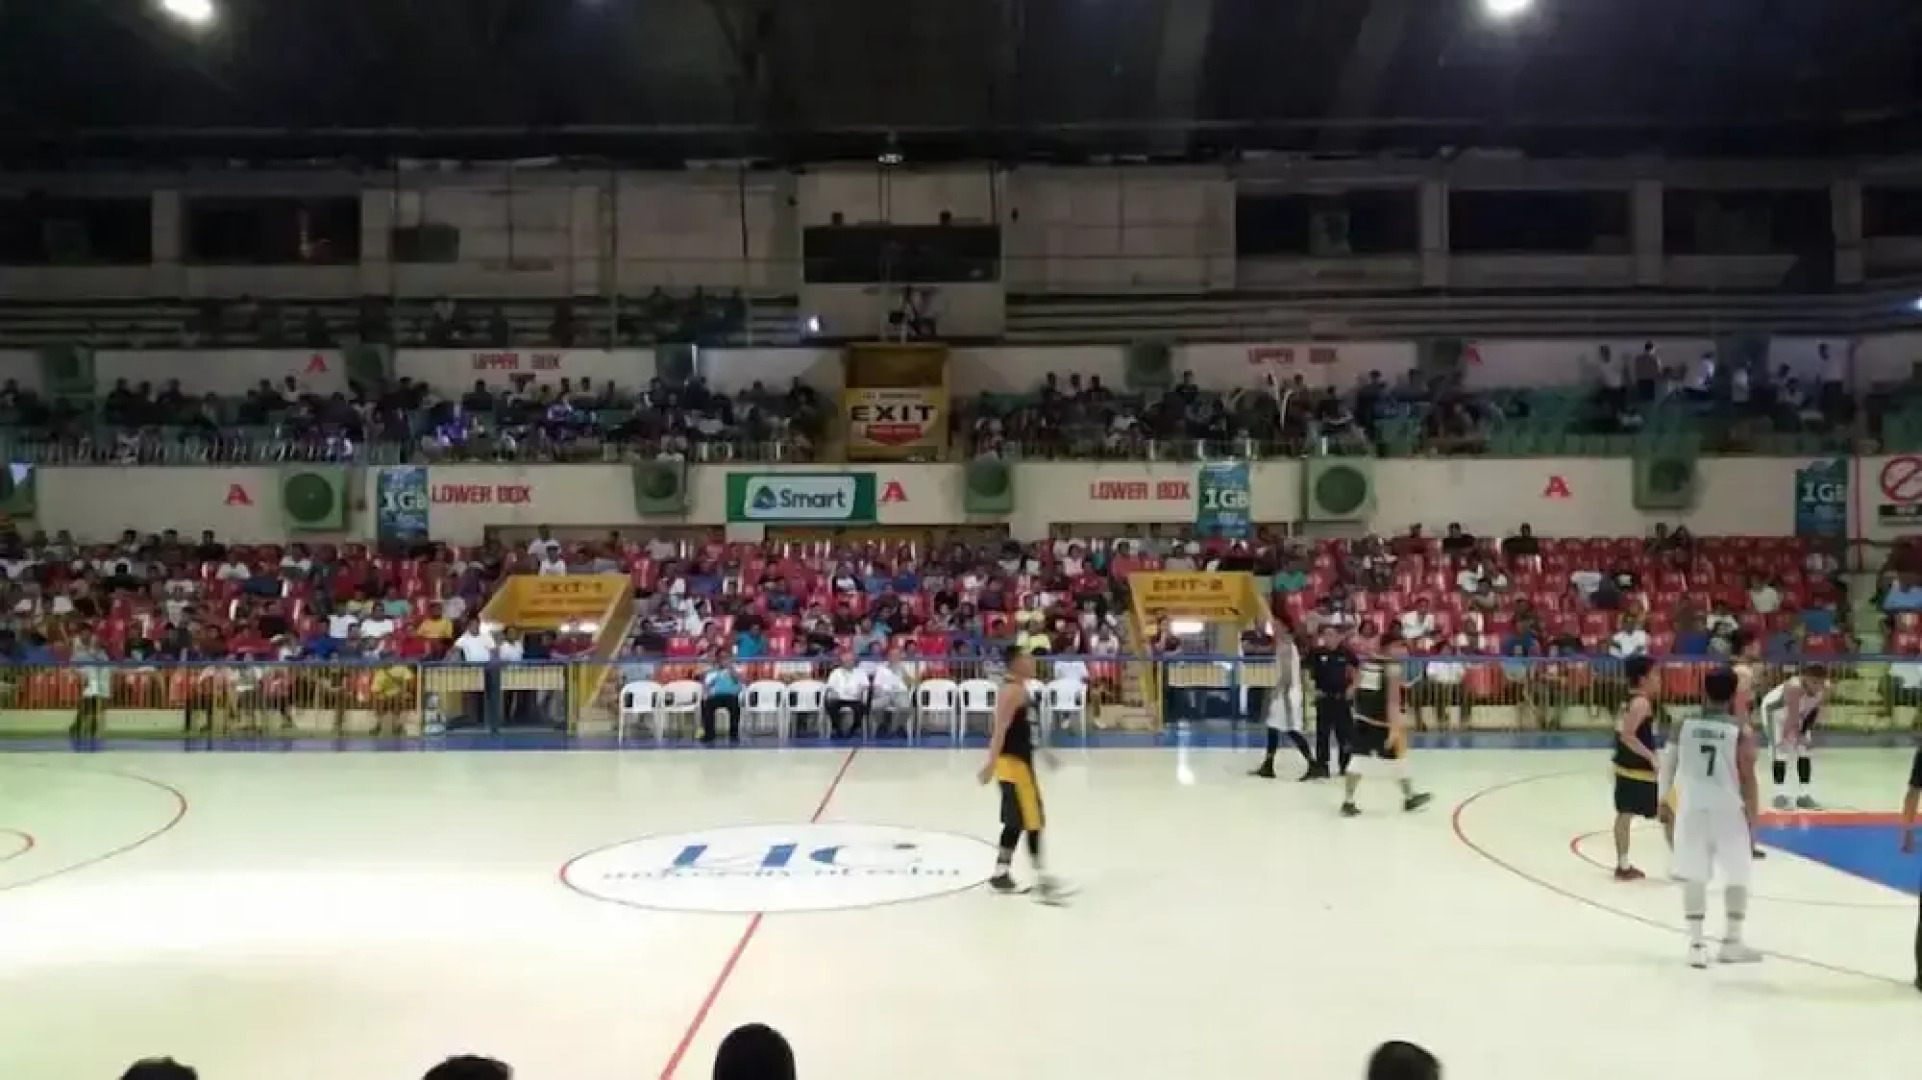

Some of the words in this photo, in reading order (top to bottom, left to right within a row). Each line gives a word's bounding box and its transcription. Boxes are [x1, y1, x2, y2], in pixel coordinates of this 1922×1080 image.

[306, 354, 329, 372] A
[472, 353, 519, 370] UPPER
[531, 353, 561, 370] BOX
[850, 404, 936, 422] EXIT
[223, 483, 255, 506] A
[430, 484, 491, 504] LOWER
[497, 484, 532, 504] BOX
[880, 480, 909, 502] A
[1090, 481, 1149, 500] LOWER
[1156, 480, 1191, 500] BOX
[1542, 475, 1573, 498] A
[779, 487, 847, 508] Smart
[1203, 487, 1249, 509] 1GB
[1699, 744, 1717, 777] 7
